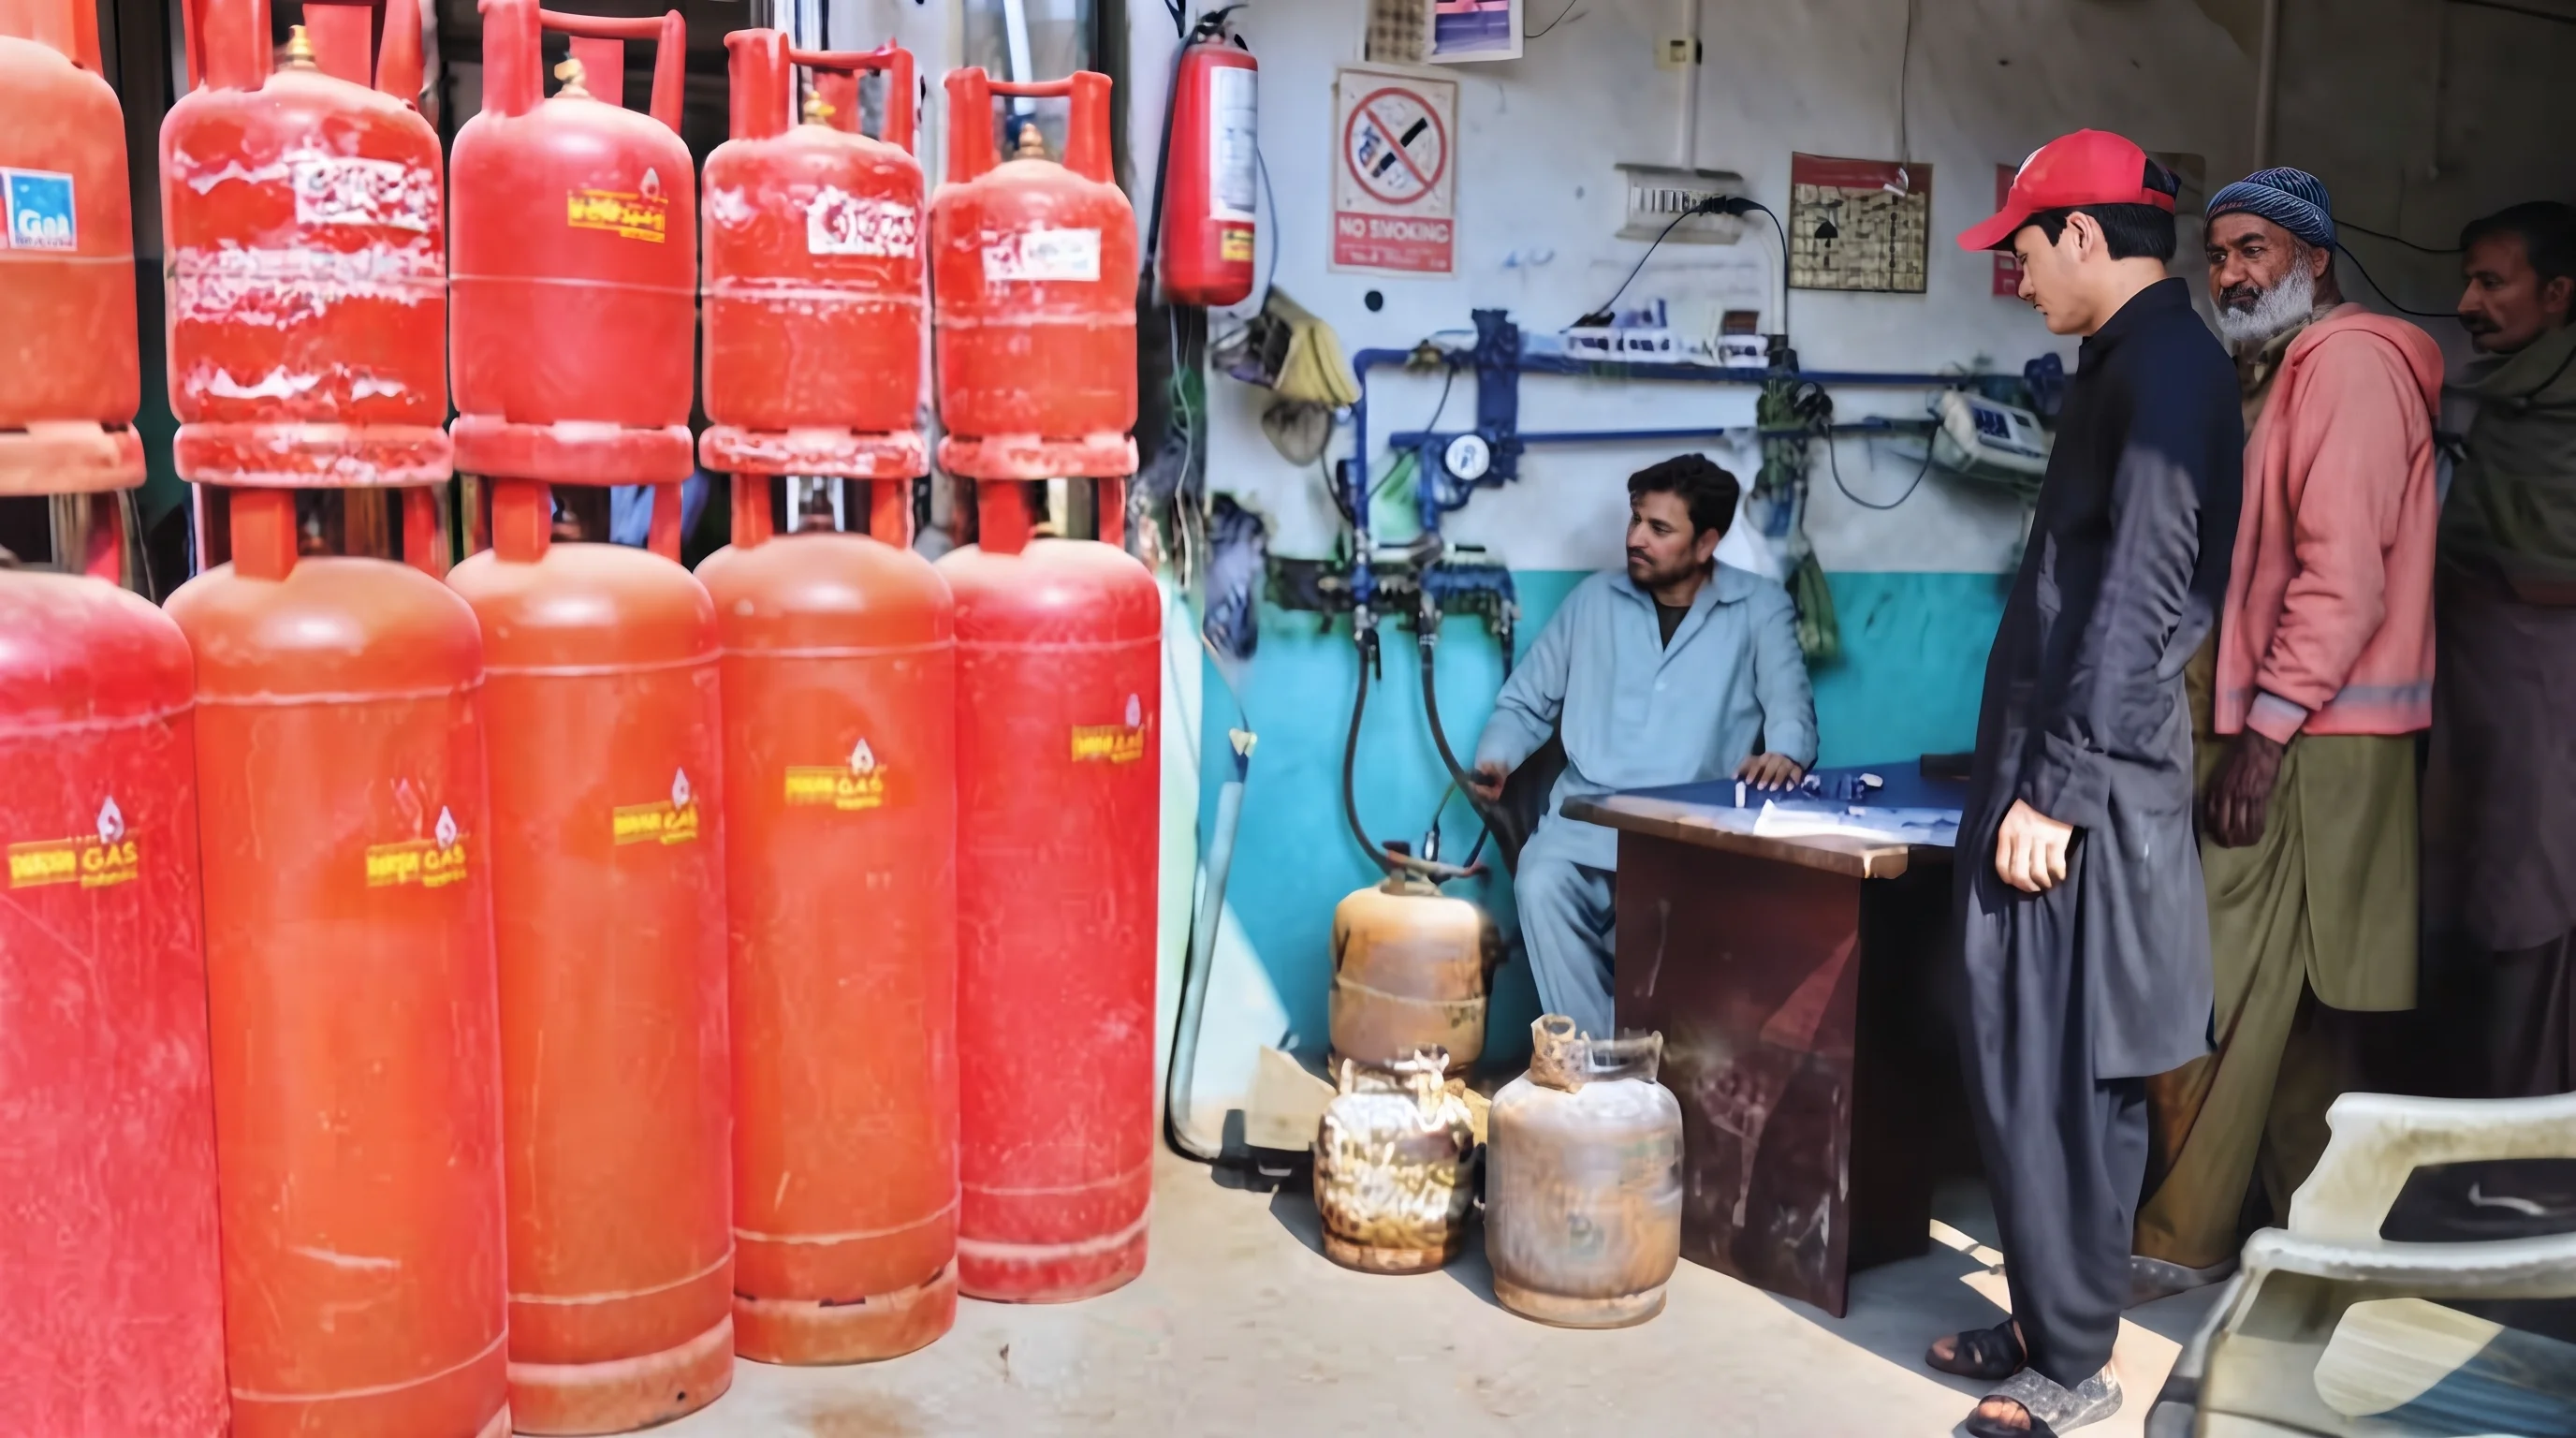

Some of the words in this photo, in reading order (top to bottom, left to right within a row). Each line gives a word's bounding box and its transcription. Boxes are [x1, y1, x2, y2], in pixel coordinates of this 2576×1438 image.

[1339, 216, 1366, 238] NO
[1369, 219, 1449, 243] SMOKING
[81, 841, 138, 873] GAS
